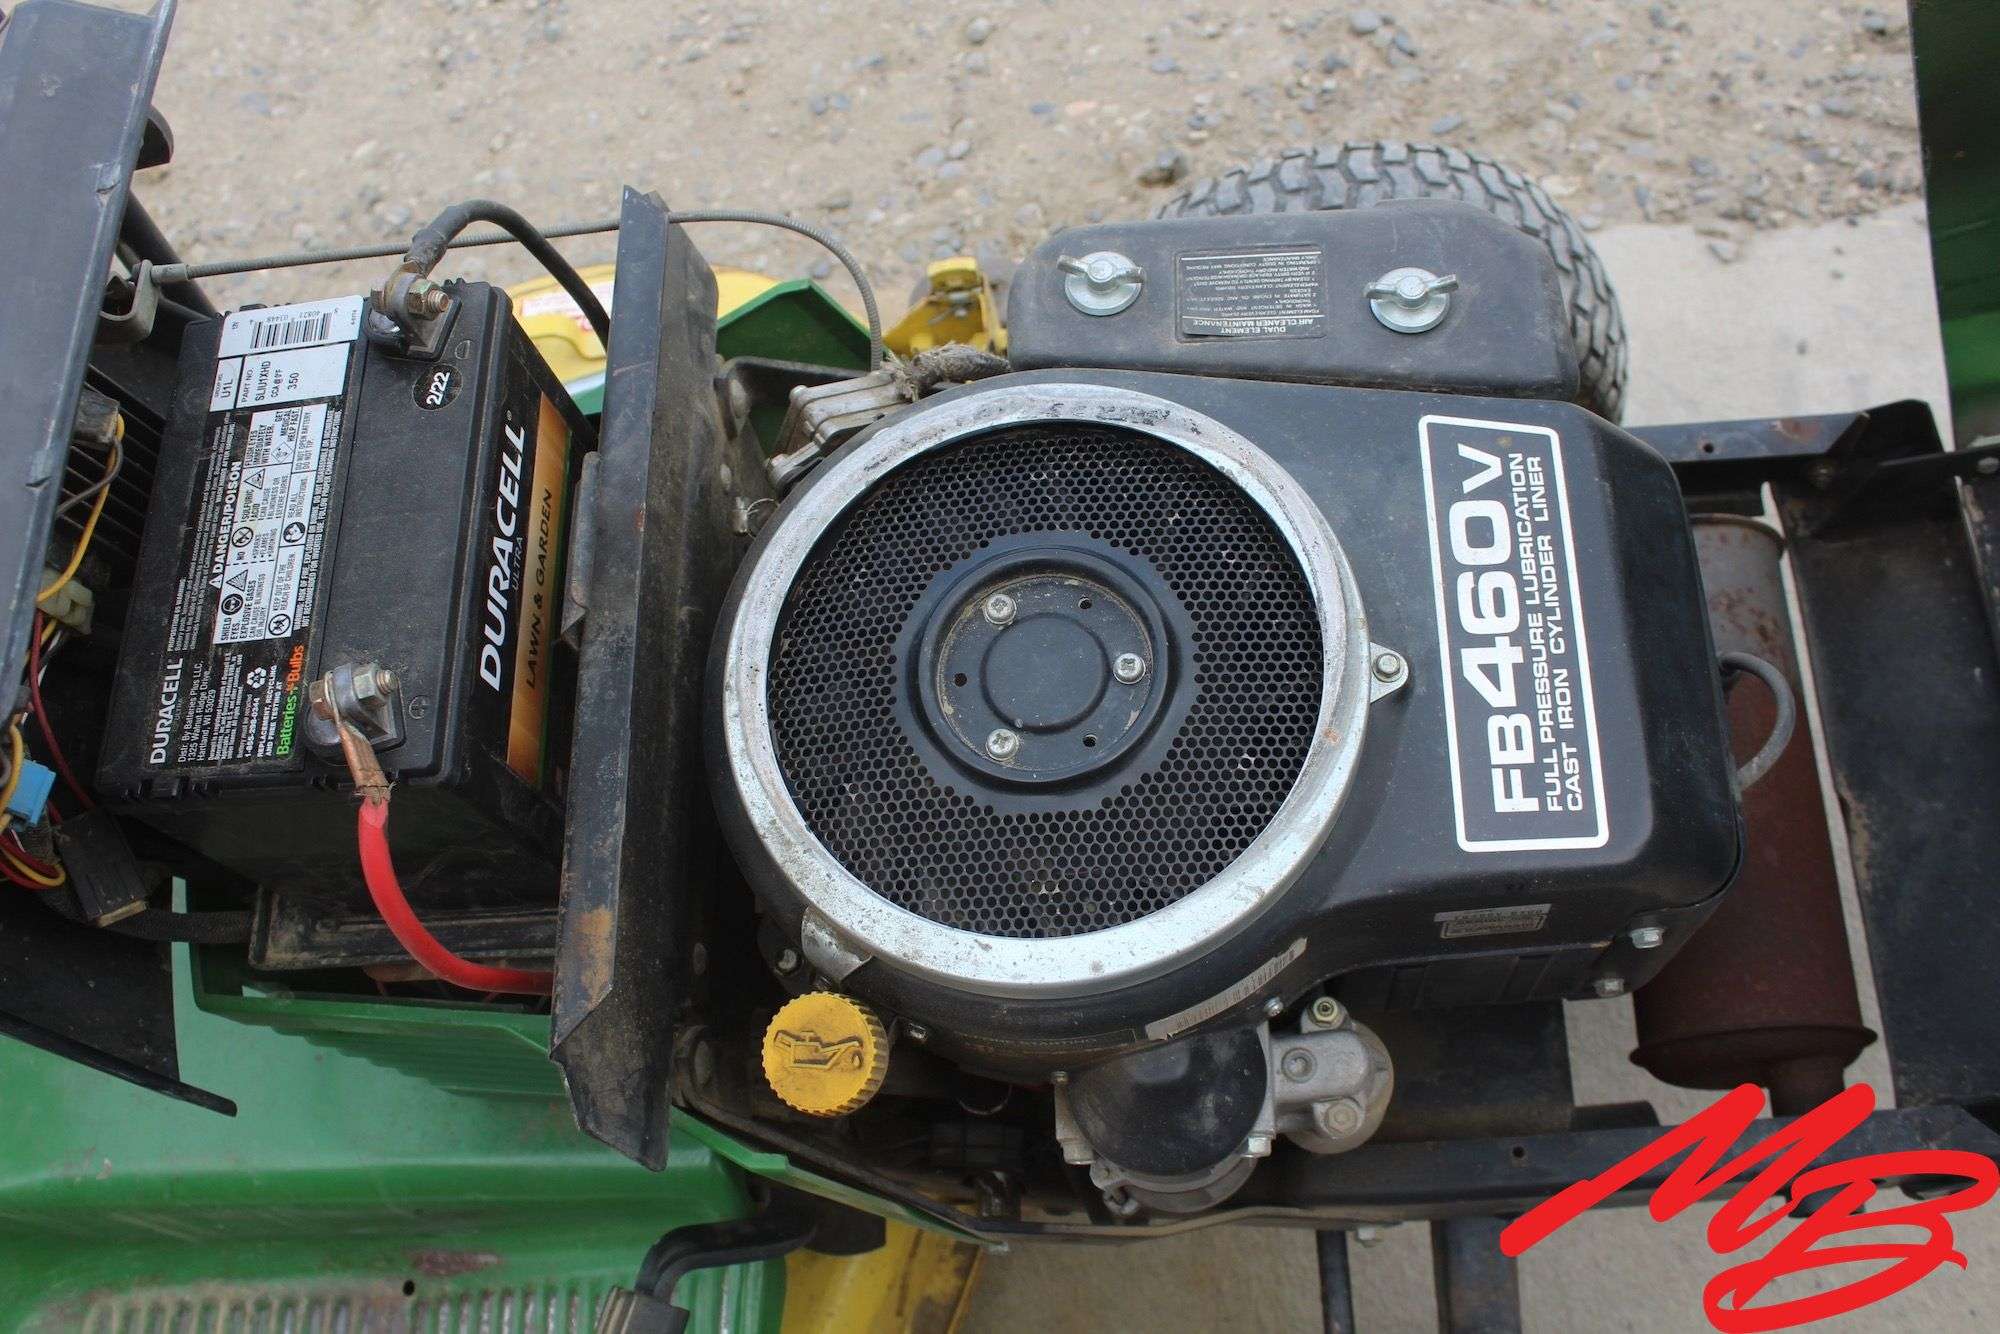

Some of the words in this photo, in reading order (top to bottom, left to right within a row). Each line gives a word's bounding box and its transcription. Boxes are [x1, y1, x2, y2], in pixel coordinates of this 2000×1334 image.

[1192, 317, 1254, 328] MAINTENANCE
[1220, 326, 1260, 334] ELEMENT
[1255, 318, 1296, 326] CLEANER
[245, 367, 253, 380] NO.
[286, 372, 299, 390] 350
[221, 378, 233, 397] U1L
[241, 382, 250, 402] PART
[425, 368, 450, 406] 2/22
[274, 410, 283, 422] GET
[280, 408, 291, 436] MEDICAL
[248, 430, 257, 445] EYES
[253, 423, 267, 464] IMMEDIATELY
[287, 425, 297, 441] HELP
[244, 446, 255, 465] FLUSH
[261, 447, 270, 463] WITH
[261, 488, 270, 505] CAUSE
[1527, 457, 1549, 521] LINER
[241, 489, 253, 519] SULFURIC
[250, 503, 259, 517] ACID
[276, 494, 285, 515] SEVERE
[212, 461, 242, 573] DANGER/POISON
[536, 488, 552, 588] GARDEN
[1508, 453, 1540, 604] LUBRICATION
[236, 551, 245, 560] NO
[481, 425, 525, 690] DURACELL
[512, 536, 525, 592] ULTRA
[245, 580, 256, 601] GASES
[1537, 535, 1565, 654] CYLINDER
[532, 593, 544, 614] &
[220, 617, 232, 639] SHIELD
[239, 603, 252, 638] EXPLOSIVE
[1449, 443, 1539, 812] FB460V
[527, 622, 542, 689] LAWN
[189, 679, 200, 695] Plus
[266, 664, 279, 703] RECYCLING
[1528, 613, 1555, 743] PRESSURE
[149, 657, 184, 763] DURACELL
[196, 691, 208, 713] Ridge
[205, 688, 216, 712] 53029
[1553, 669, 1574, 729] IRON
[184, 696, 197, 728] Batteries
[203, 714, 212, 725] WI
[181, 730, 192, 740] By
[191, 714, 203, 741] Walnut
[187, 742, 198, 760] 1325
[264, 741, 273, 755] AND
[1543, 749, 1563, 811] FULL
[1562, 742, 1583, 811] CAST
